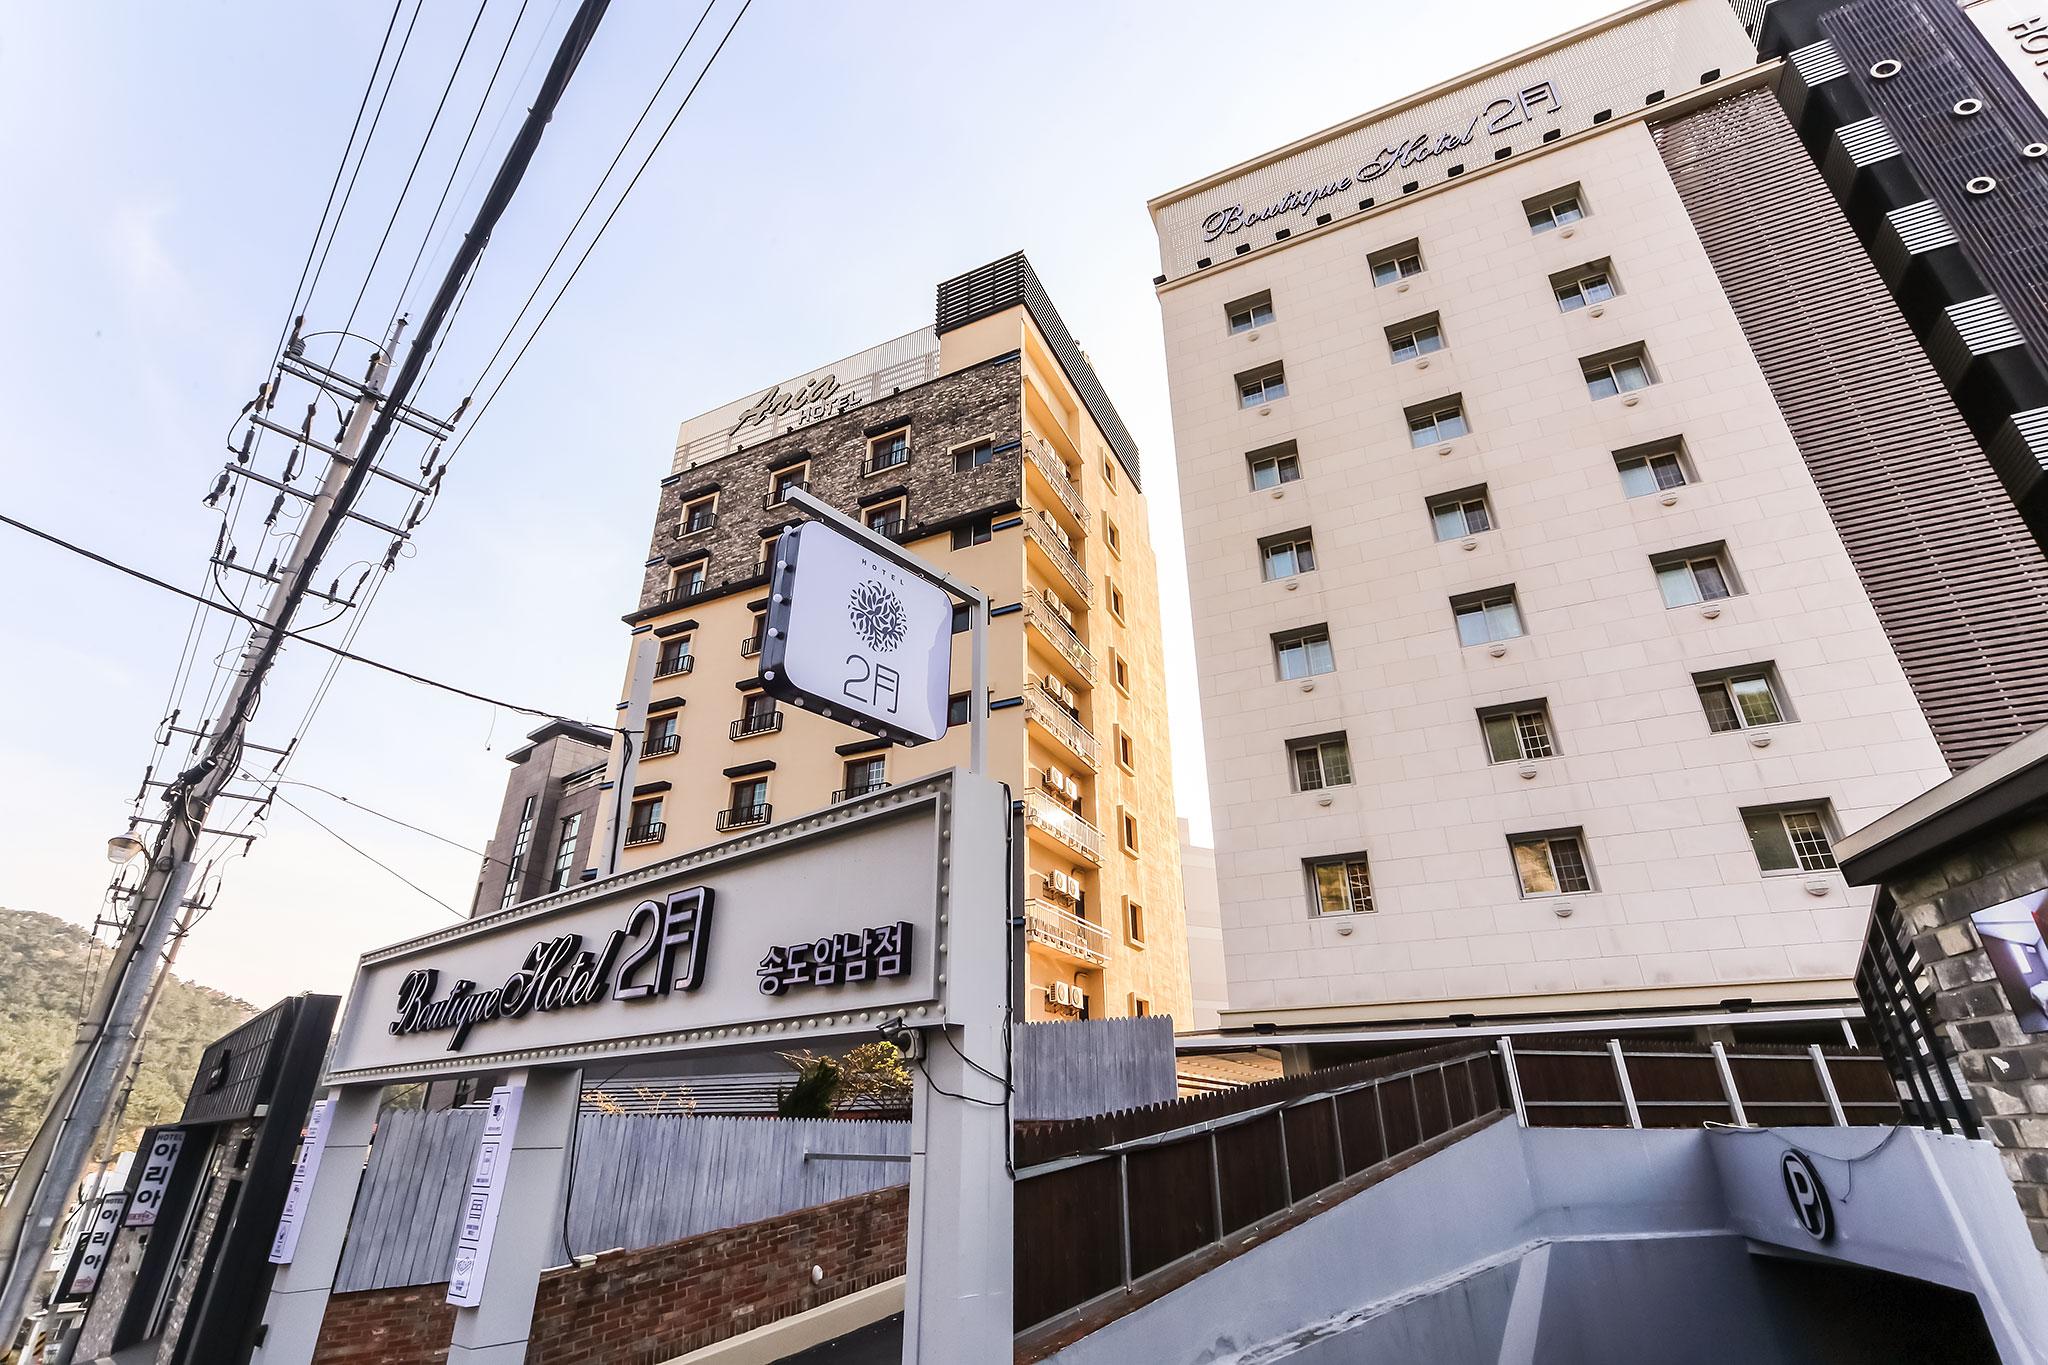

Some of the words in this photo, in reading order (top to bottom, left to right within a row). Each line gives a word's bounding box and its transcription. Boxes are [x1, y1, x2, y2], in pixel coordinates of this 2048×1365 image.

[1203, 175, 1353, 243] Boutique
[1356, 117, 1478, 183] Hotel
[729, 373, 841, 436] Aria
[798, 391, 863, 426] HOTEL
[861, 558, 905, 586] HOTEL
[388, 969, 502, 1052] Boutique
[500, 929, 625, 1018] Hotel
[756, 921, 914, 997] 송도암남점
[137, 1143, 178, 1209] 아리아
[1785, 1160, 1815, 1230] P
[84, 1209, 118, 1270] 아리아
